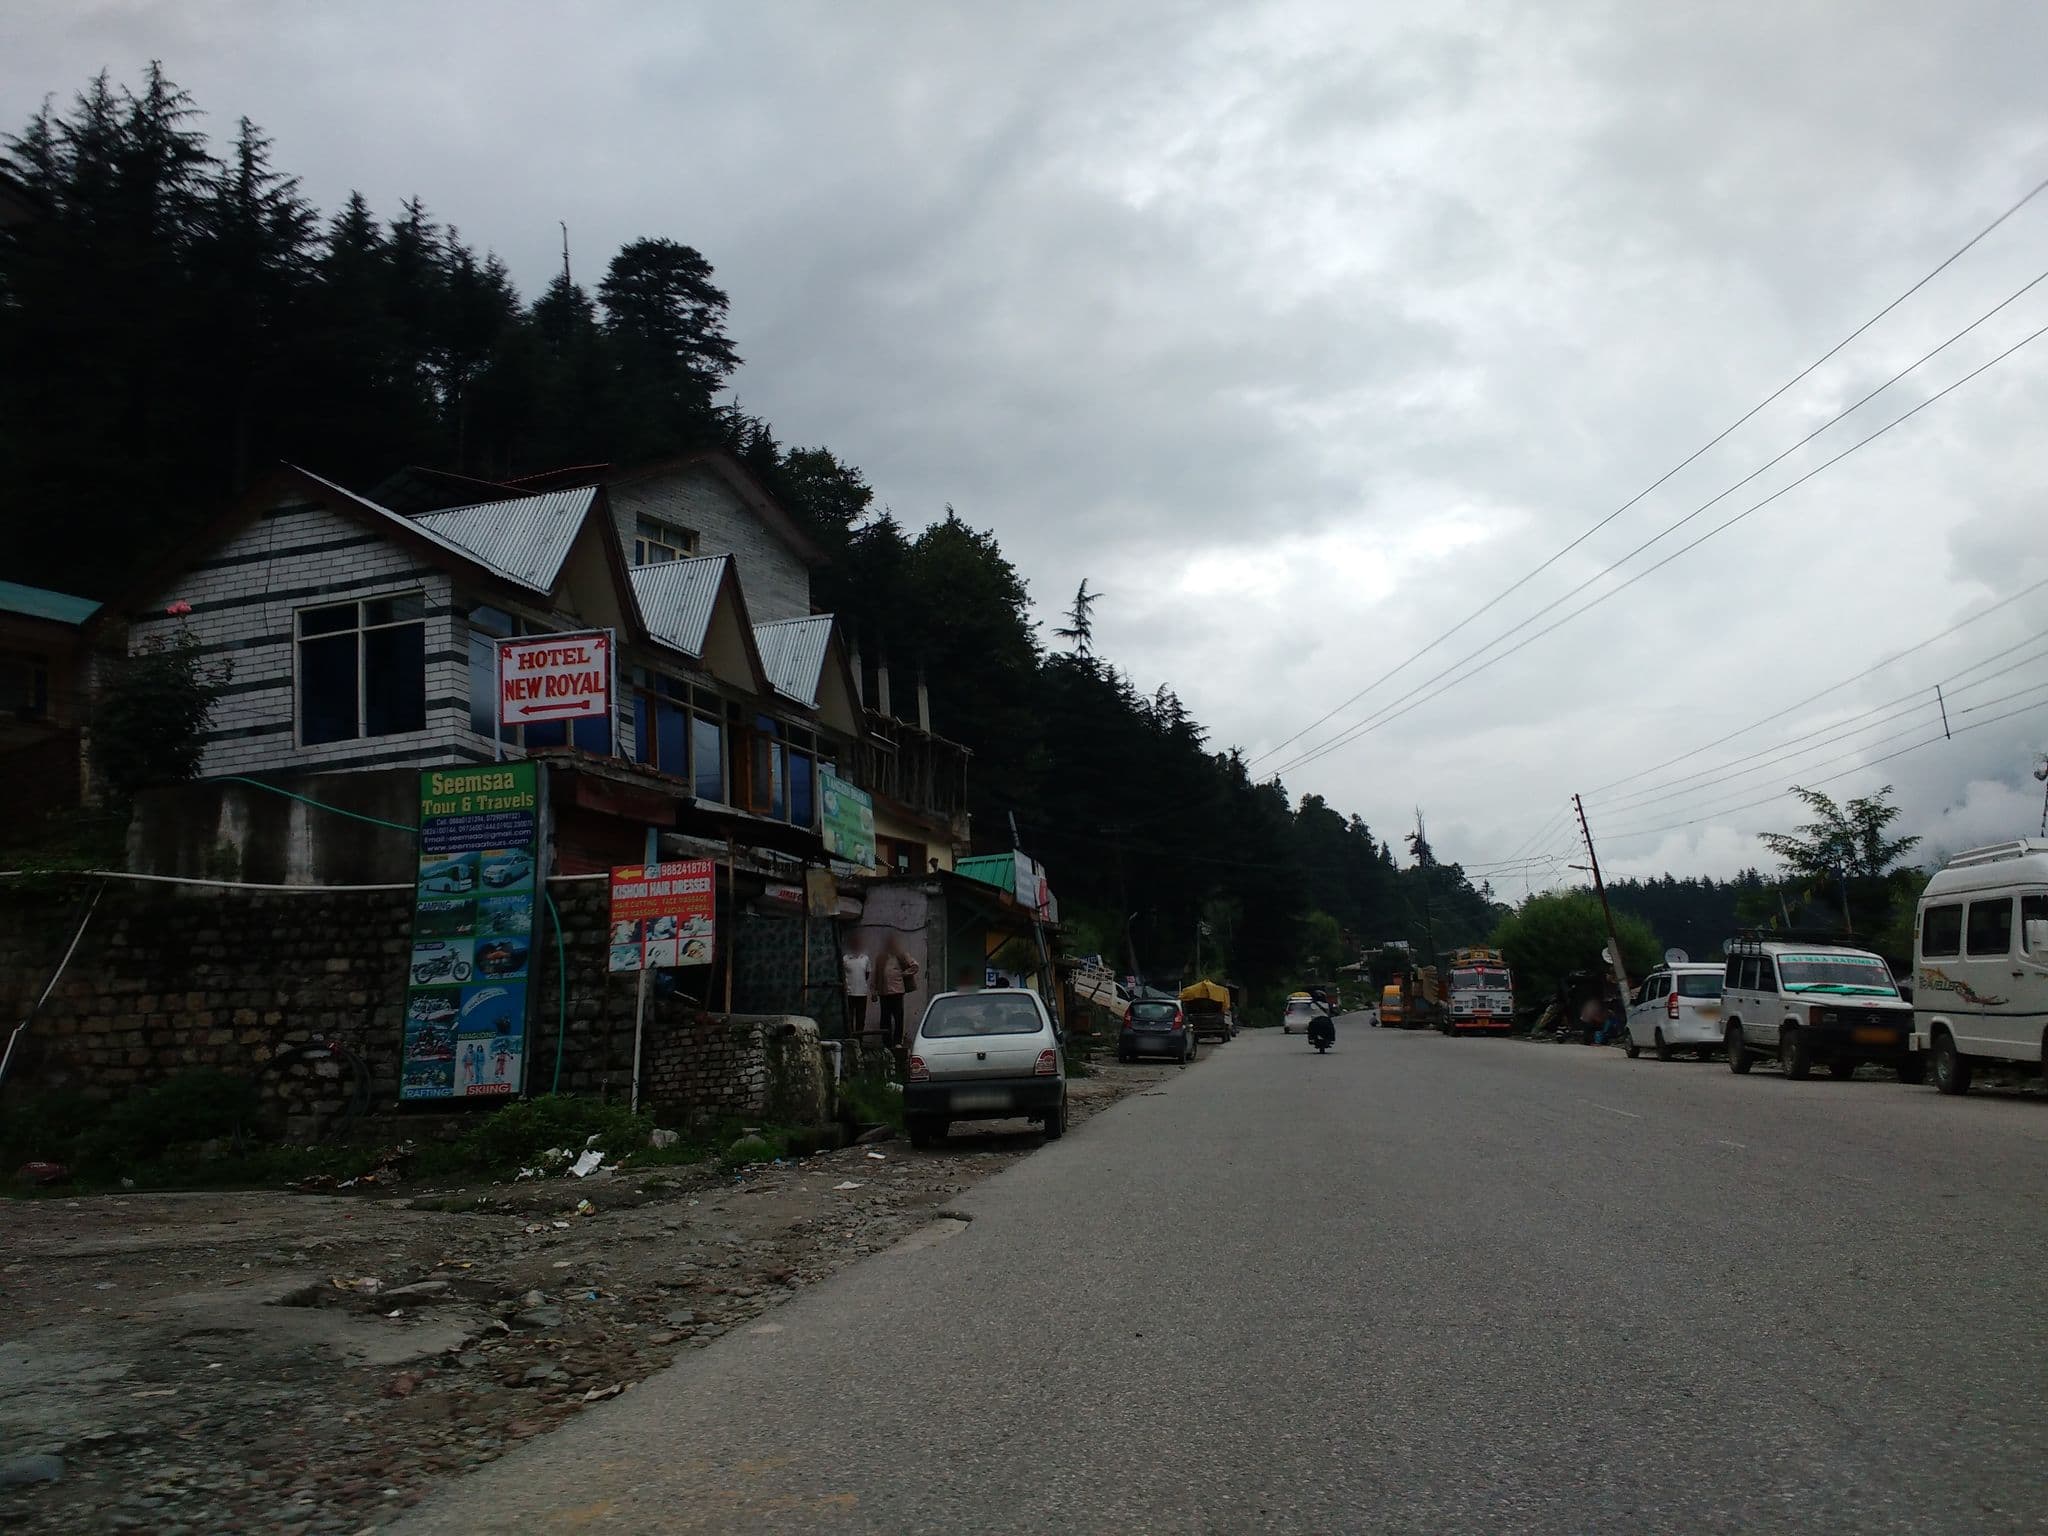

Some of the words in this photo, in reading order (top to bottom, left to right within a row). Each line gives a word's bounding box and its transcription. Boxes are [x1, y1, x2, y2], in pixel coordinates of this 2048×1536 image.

[518, 649, 592, 671] HOTEL
[505, 675, 544, 702] NEW
[545, 671, 604, 698] ROYAL
[431, 772, 515, 796] Seemsaa
[422, 799, 457, 815] Tour
[462, 796, 473, 812] &
[476, 791, 534, 811] Travels
[650, 880, 671, 896] HAIR
[672, 878, 711, 895] DRESSER
[407, 1088, 450, 1098] RAFTING
[468, 1085, 511, 1096] SKIING
